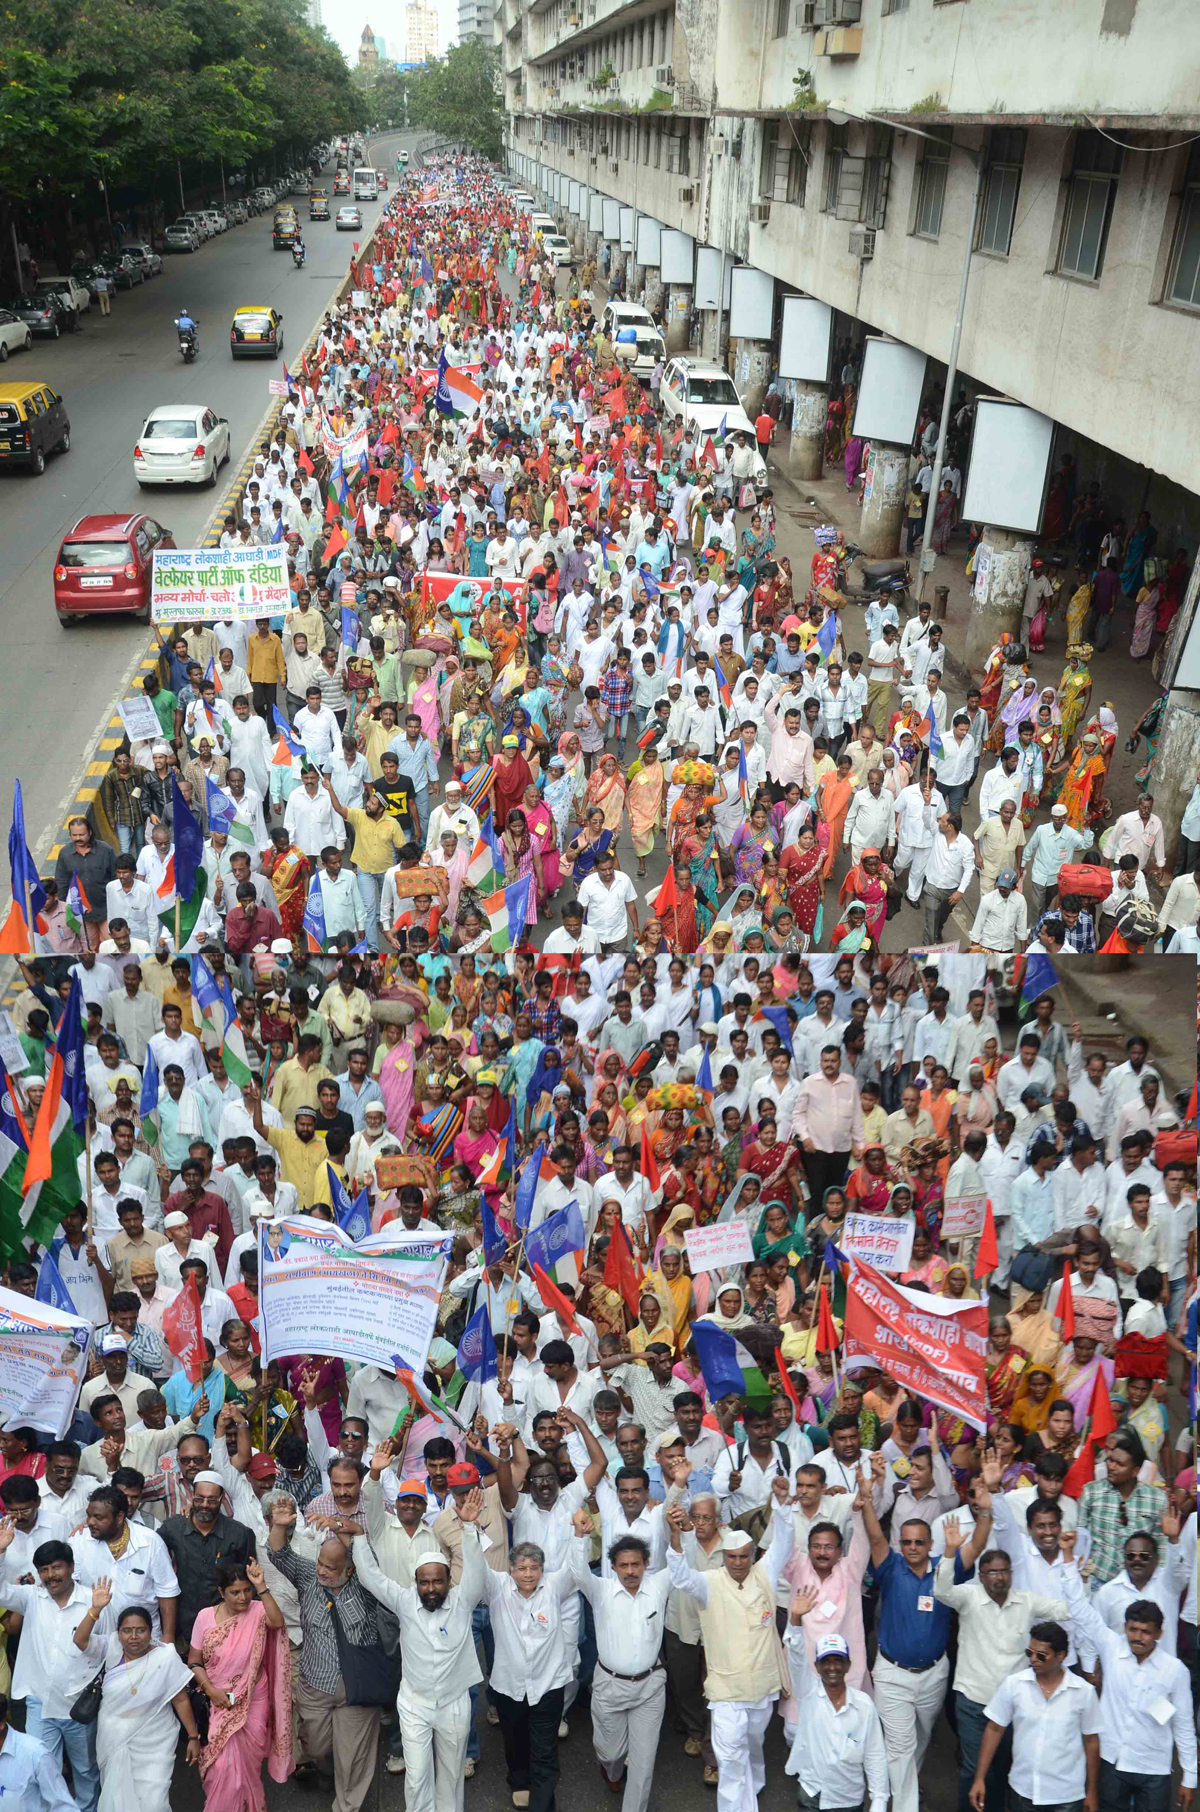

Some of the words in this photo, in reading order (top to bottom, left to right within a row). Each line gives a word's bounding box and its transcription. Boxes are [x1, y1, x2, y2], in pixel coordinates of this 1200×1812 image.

[155, 554, 192, 566] महाराष्ट्र
[195, 550, 232, 564] लोकशाही
[155, 567, 195, 587] वेल्फेयर
[197, 566, 218, 587] पार्टी
[220, 566, 245, 586] ऑफ
[154, 592, 180, 603] भव्य
[181, 589, 206, 602] मोर्चा
[211, 588, 230, 603] चलो
[265, 586, 288, 600] मैदान
[66, 1276, 77, 1284] जय
